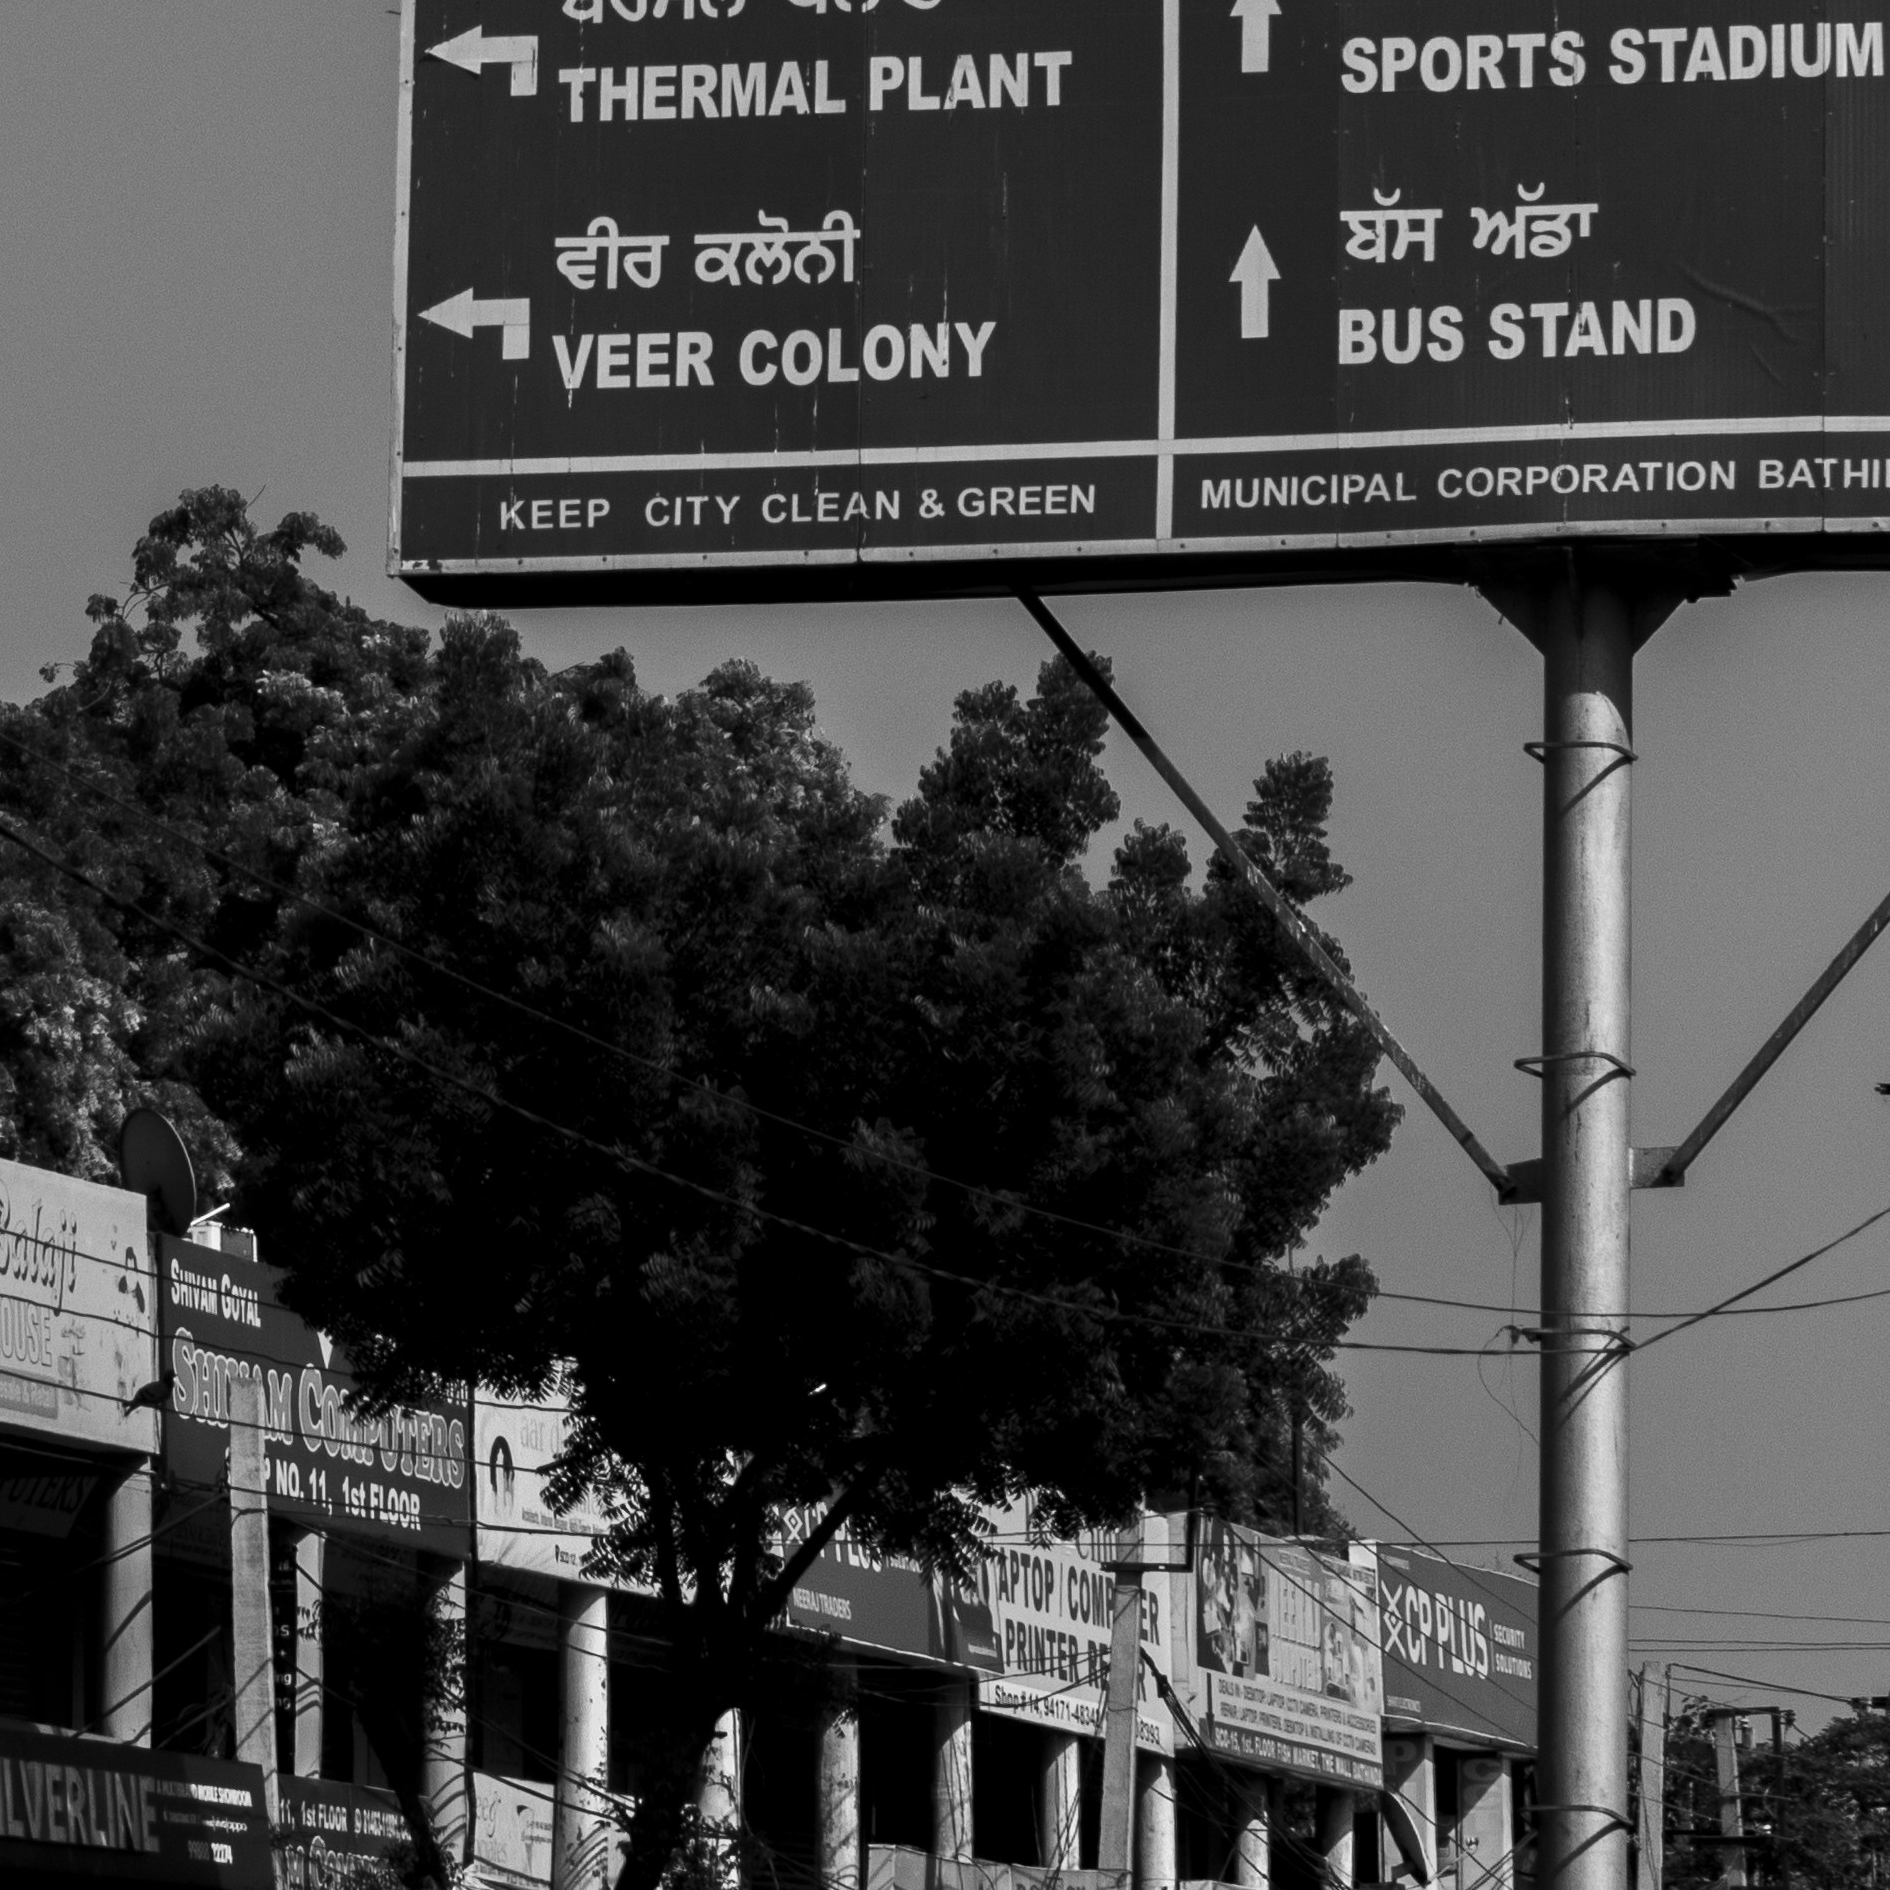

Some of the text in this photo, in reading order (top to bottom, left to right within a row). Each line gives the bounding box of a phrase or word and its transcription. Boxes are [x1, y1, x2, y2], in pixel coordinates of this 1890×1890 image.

[558, 51, 1072, 122] THERMAL PLANT
[1341, 22, 1884, 93] SPORTS STADIUM
[555, 210, 860, 290] ਵੀਰ ਕਲੋਨੀ
[1341, 182, 1598, 263] ਬੱਸ ਅੱਡਾ
[553, 321, 996, 390] VEER COLONY
[1339, 298, 1695, 364] BUS STAND
[500, 485, 1096, 530] KEEP CITY CLEAN & GREEN
[1201, 473, 1416, 509] MUNICIPAL
[1437, 461, 1736, 499] CORPORATION
[170, 1258, 261, 1328] SHIVAM GOYAL
[276, 1459, 305, 1502] NO.
[309, 1468, 333, 1519] 11,
[342, 1476, 367, 1518] 1st
[370, 1483, 422, 1532] FLOOR
[1005, 1618, 1080, 1685] PRINTER
[1405, 1585, 1489, 1680] CP PLUS
[1493, 1623, 1525, 1650] SECURITY
[1495, 1653, 1533, 1680] SOLUTIONS
[301, 1800, 317, 1828] 1st
[318, 1803, 348, 1832] FLOOR
